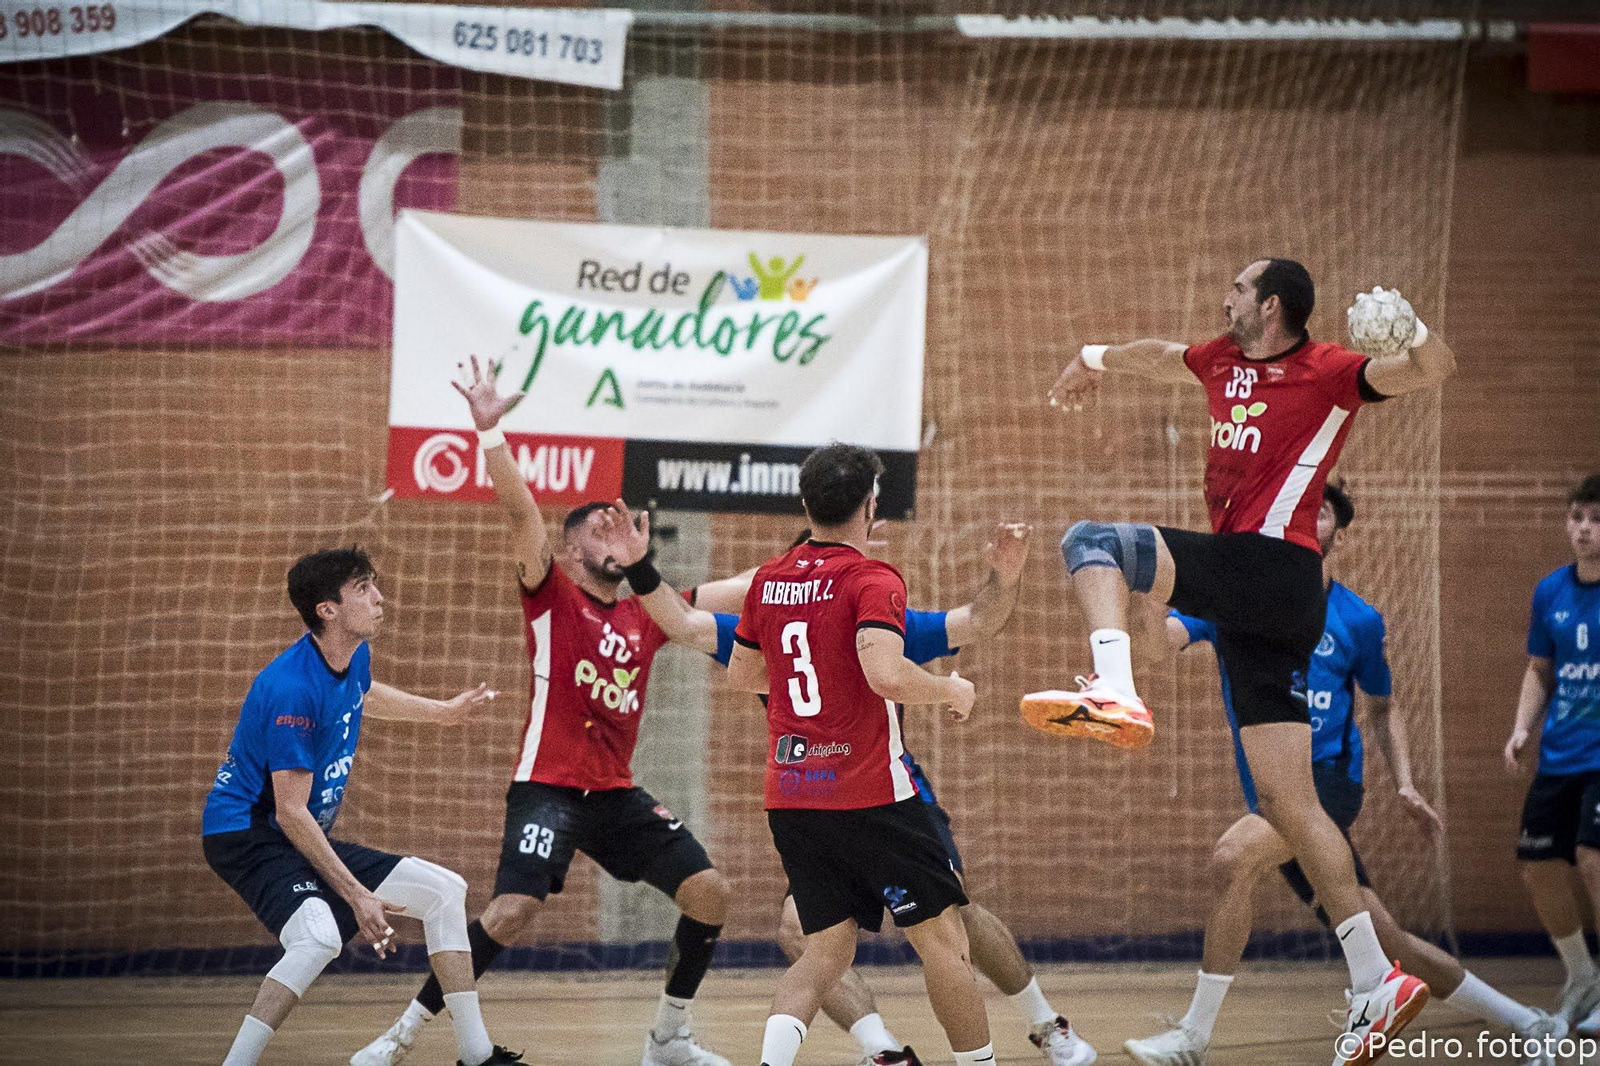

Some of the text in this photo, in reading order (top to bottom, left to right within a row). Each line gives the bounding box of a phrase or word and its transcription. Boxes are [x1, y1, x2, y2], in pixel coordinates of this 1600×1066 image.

[15, 8, 62, 38] 908
[69, 3, 116, 34] 359
[453, 21, 602, 64] 625 081 703
[578, 260, 690, 295] Red de
[508, 270, 832, 392] ganadores
[1210, 416, 1262, 454] roin
[476, 443, 594, 492] IMUV
[658, 454, 801, 495] www.inm
[780, 621, 822, 717] 3
[519, 823, 554, 859] 33
